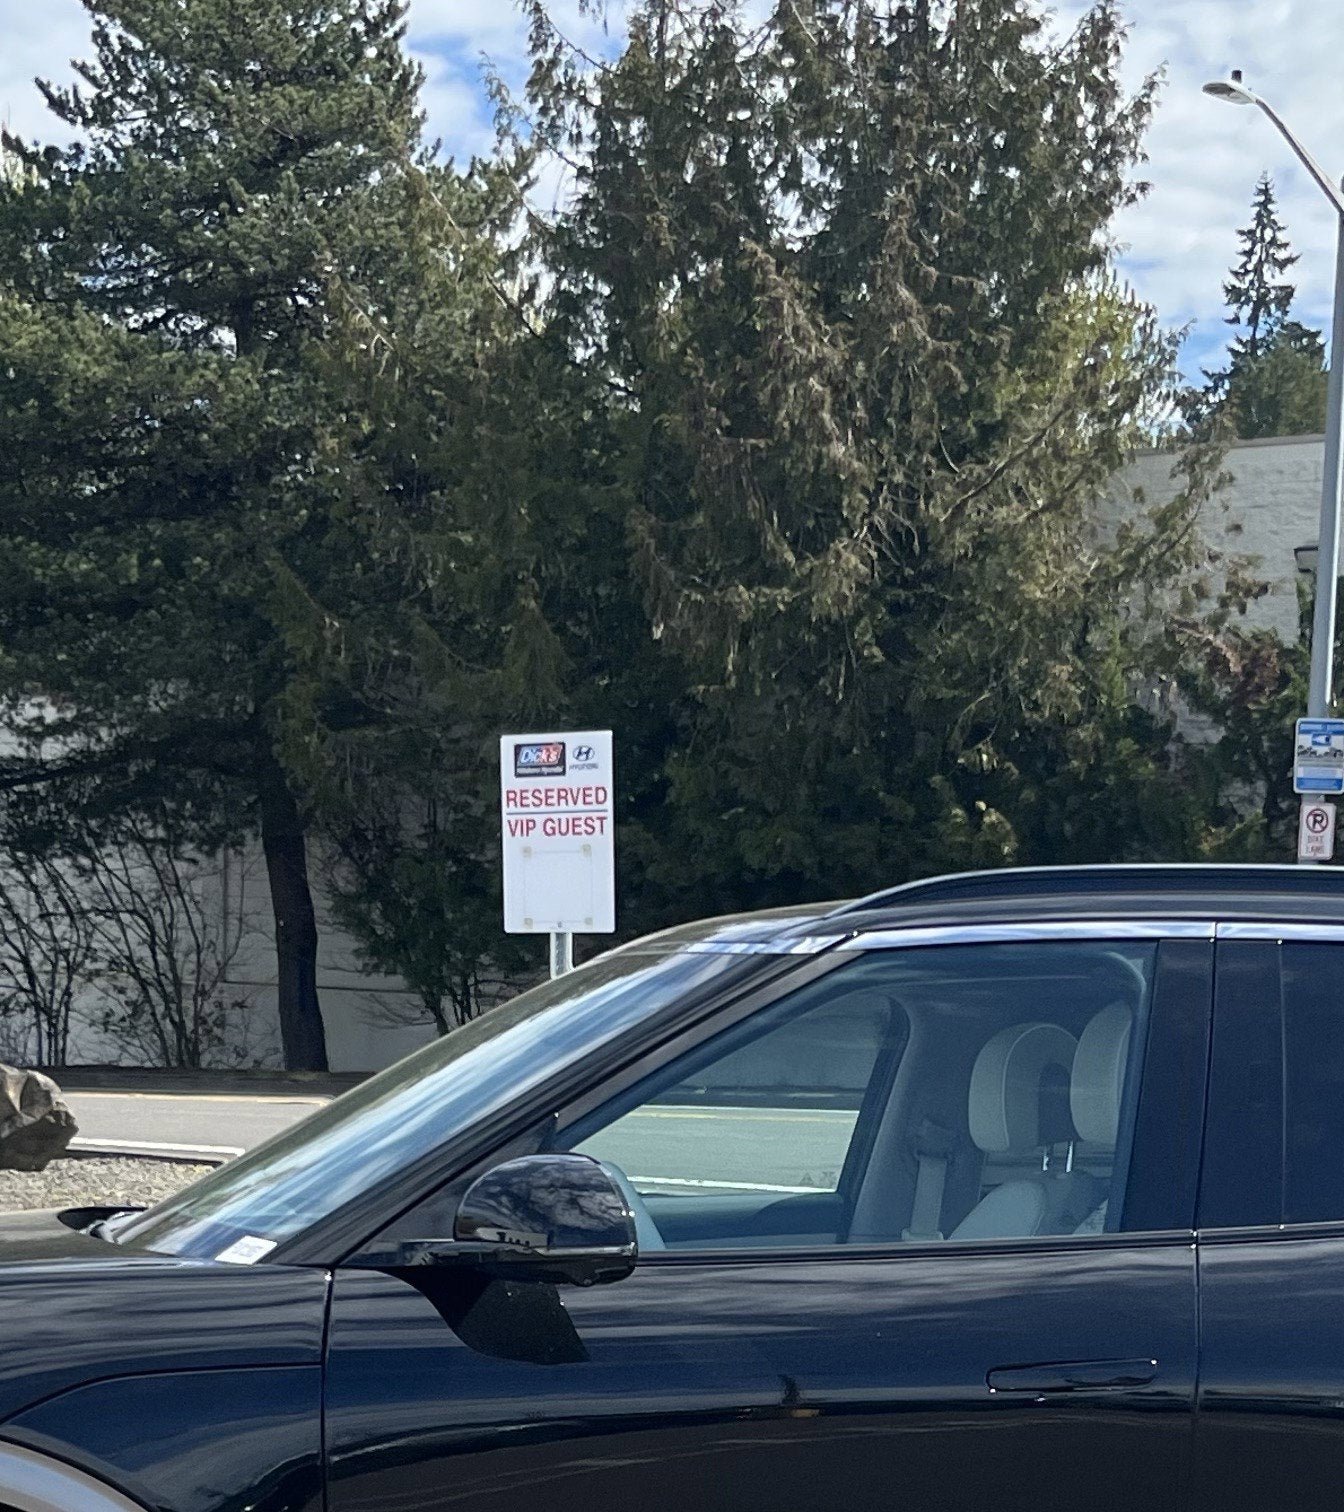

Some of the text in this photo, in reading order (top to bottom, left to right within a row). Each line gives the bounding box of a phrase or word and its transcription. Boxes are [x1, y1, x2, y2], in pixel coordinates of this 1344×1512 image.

[506, 786, 608, 808] RESERVED
[507, 816, 608, 837] VIP GUEST
